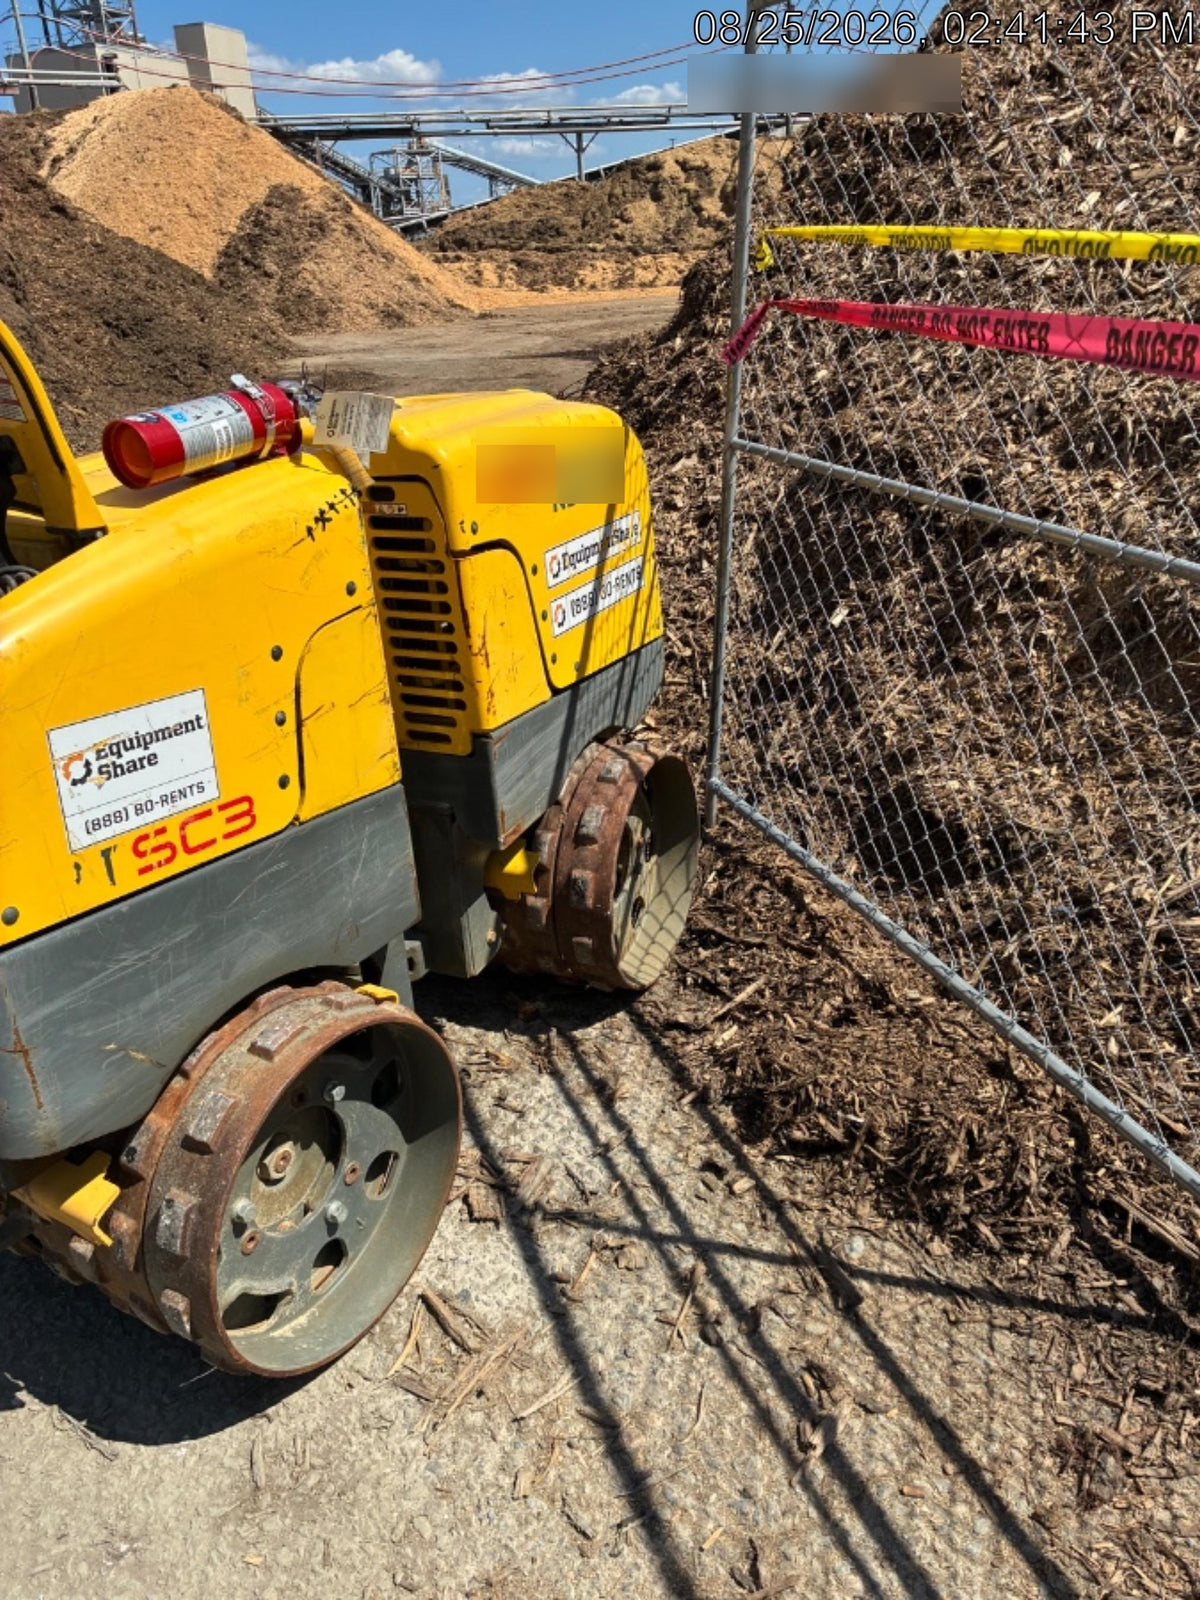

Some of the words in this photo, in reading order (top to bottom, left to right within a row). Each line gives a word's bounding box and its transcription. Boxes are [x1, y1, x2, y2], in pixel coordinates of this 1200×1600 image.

[993, 317, 1051, 351] ENTER
[1105, 327, 1199, 375] DANGER
[95, 714, 204, 761] Equipment
[97, 752, 159, 782] Share
[84, 807, 130, 835] (888)
[134, 781, 206, 817] 80-RENTS
[132, 795, 257, 876] SC3
